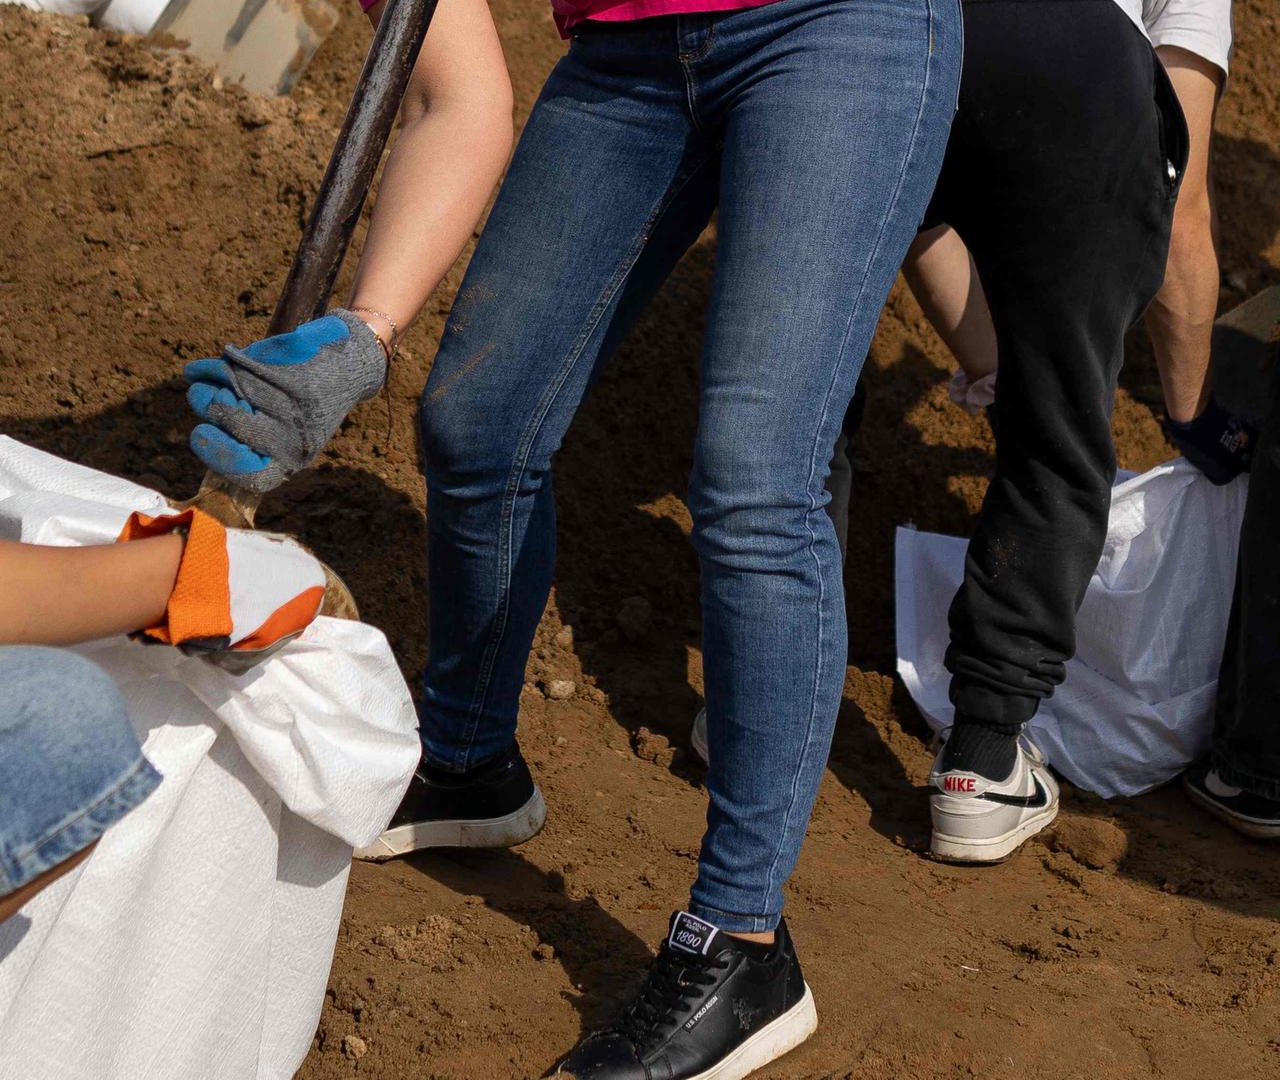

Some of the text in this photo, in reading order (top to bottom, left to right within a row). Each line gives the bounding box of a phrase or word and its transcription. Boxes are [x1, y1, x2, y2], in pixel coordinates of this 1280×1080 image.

[944, 776, 976, 792] NIKE
[676, 930, 701, 948] 1890
[693, 1007, 707, 1022] POLO
